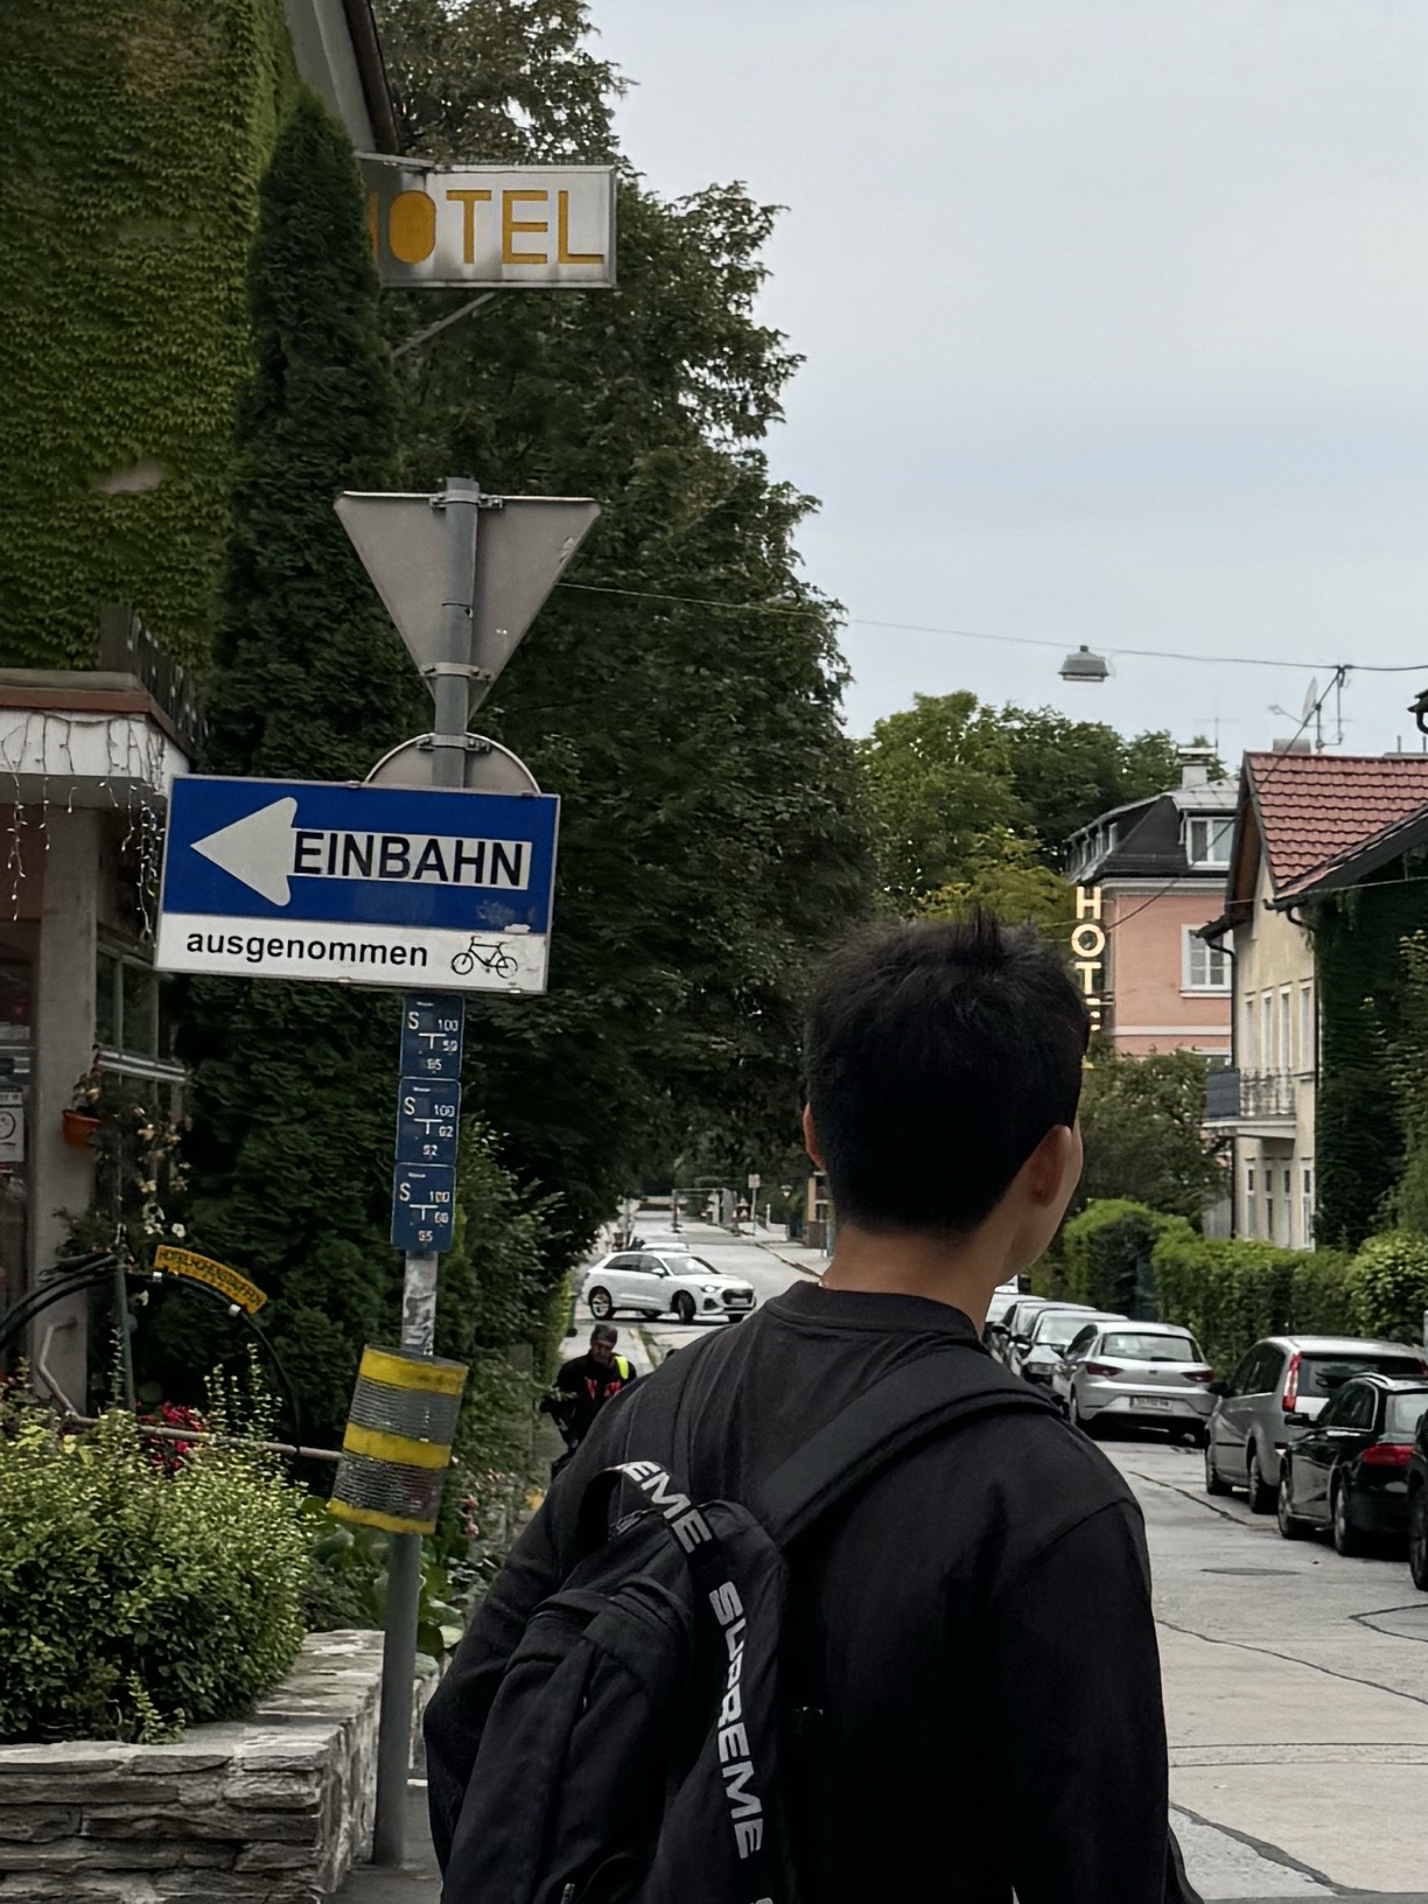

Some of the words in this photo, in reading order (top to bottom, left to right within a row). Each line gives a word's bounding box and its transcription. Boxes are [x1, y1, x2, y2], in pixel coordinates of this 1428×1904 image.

[293, 831, 523, 887] EINBAHN
[187, 932, 428, 967] ausgenommen
[1072, 886, 1105, 1068] HOT
[407, 1011, 419, 1030] S
[438, 1018, 459, 1032] 100
[404, 1096, 416, 1116] S
[434, 1104, 455, 1118] 100
[399, 1182, 411, 1202] S
[429, 1190, 450, 1203] 100
[618, 1461, 712, 1554] EME
[709, 1580, 764, 1860] SUPREME
